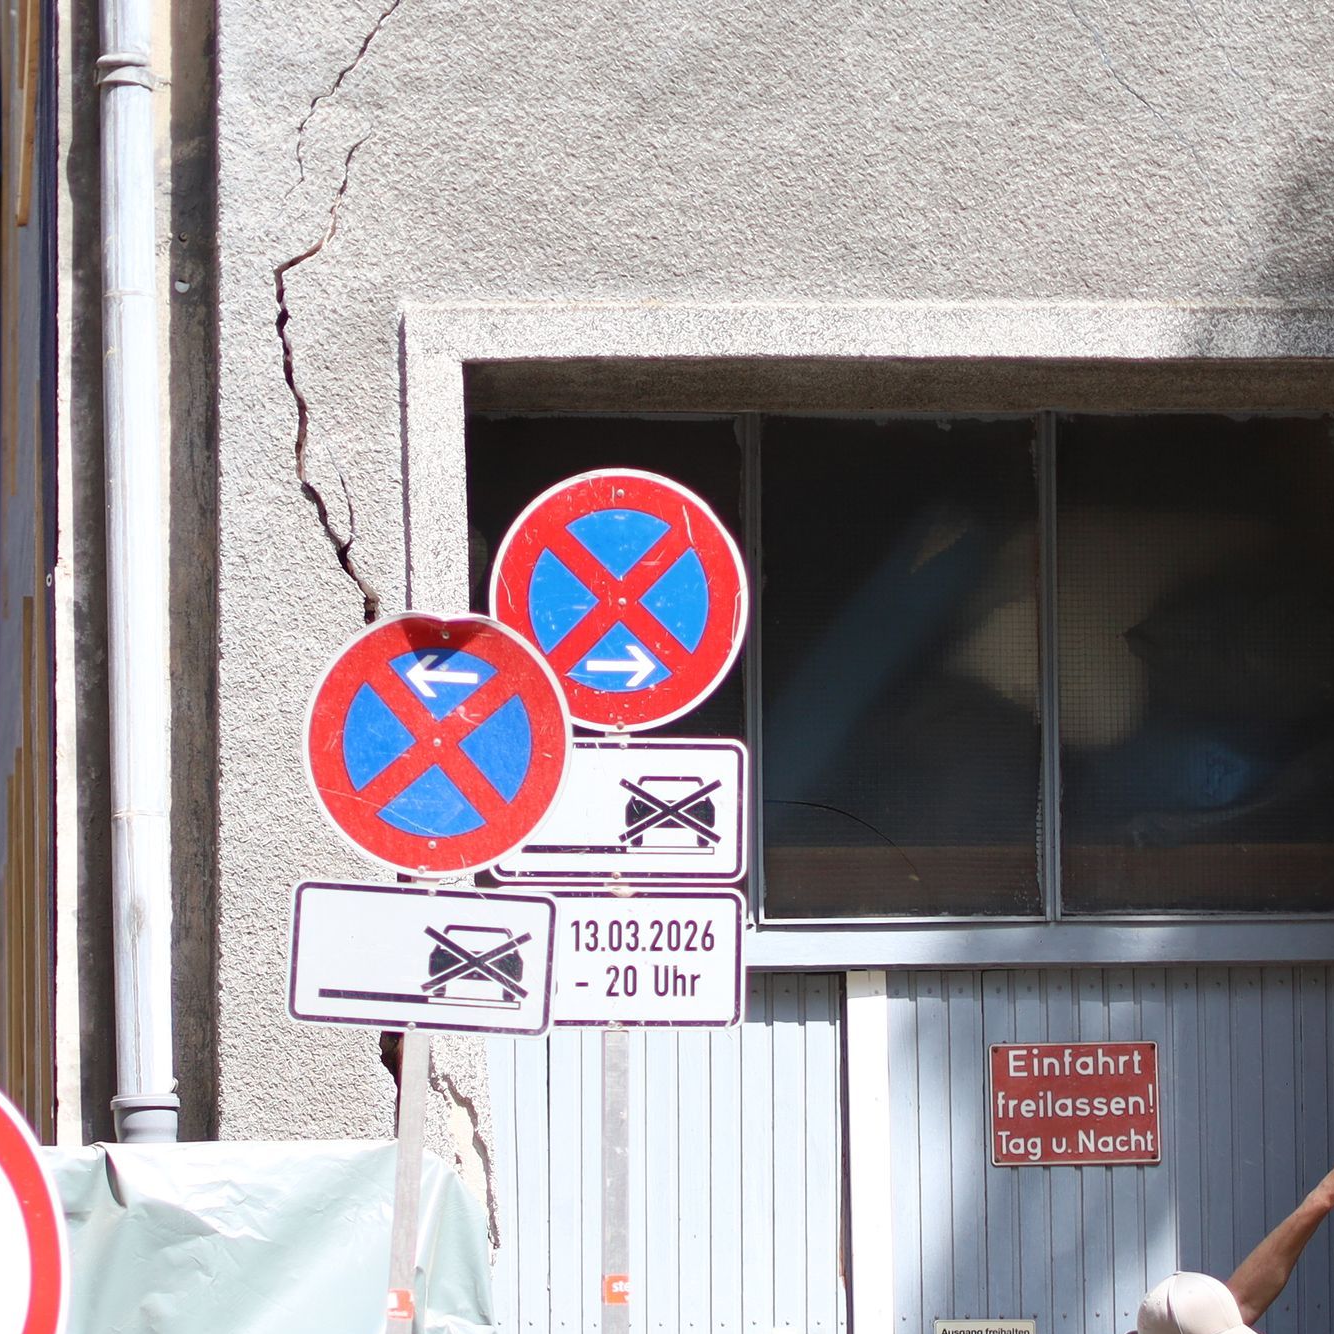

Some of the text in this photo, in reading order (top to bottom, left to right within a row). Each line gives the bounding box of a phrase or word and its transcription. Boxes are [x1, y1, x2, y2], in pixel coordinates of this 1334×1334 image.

[570, 919, 715, 952] 13.03.2026
[605, 965, 637, 997] 20
[653, 965, 701, 997] Uhr
[1008, 1048, 1142, 1077] Einfahrt
[997, 1083, 1155, 1118] freilassen!
[997, 1128, 1155, 1161] Tag u. Nacht
